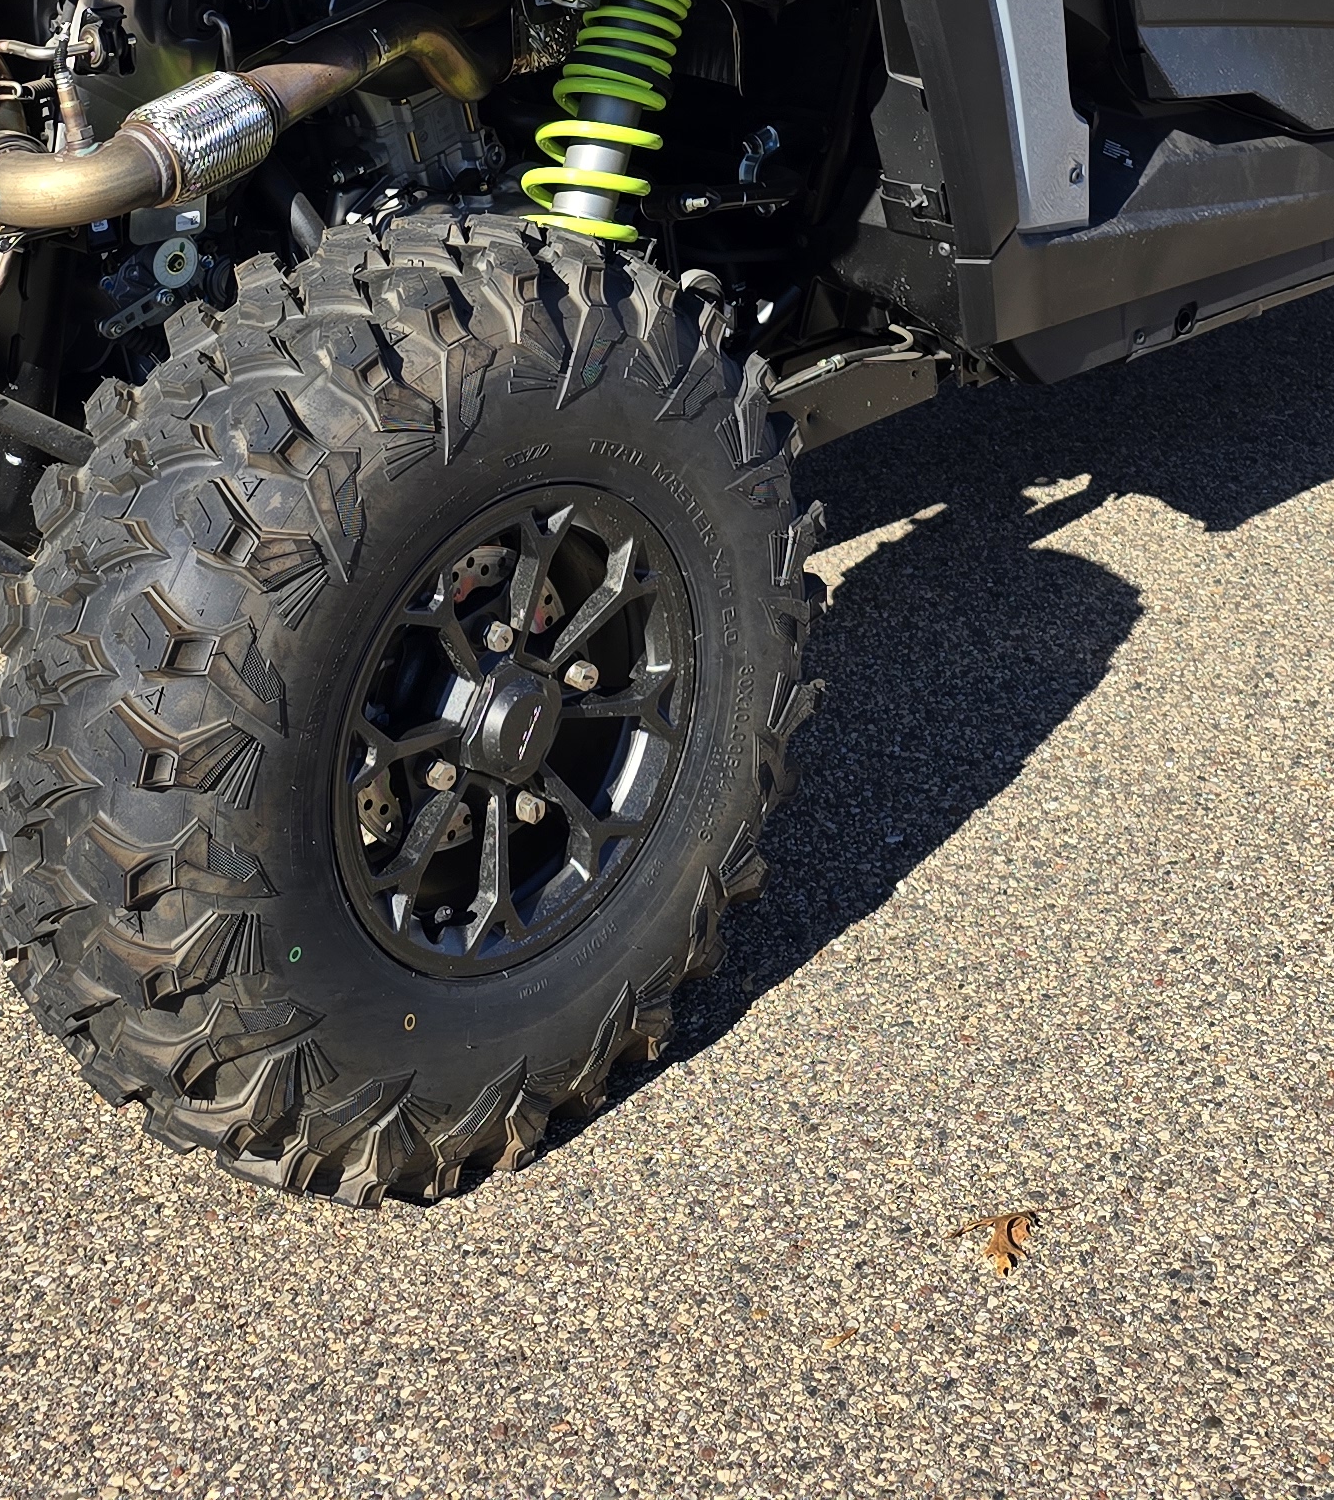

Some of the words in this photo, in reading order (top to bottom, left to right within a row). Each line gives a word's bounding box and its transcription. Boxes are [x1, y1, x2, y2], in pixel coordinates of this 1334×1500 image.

[589, 437, 648, 471] TRAIL
[650, 461, 717, 548] MASTER
[570, 920, 618, 967] RADIAL
